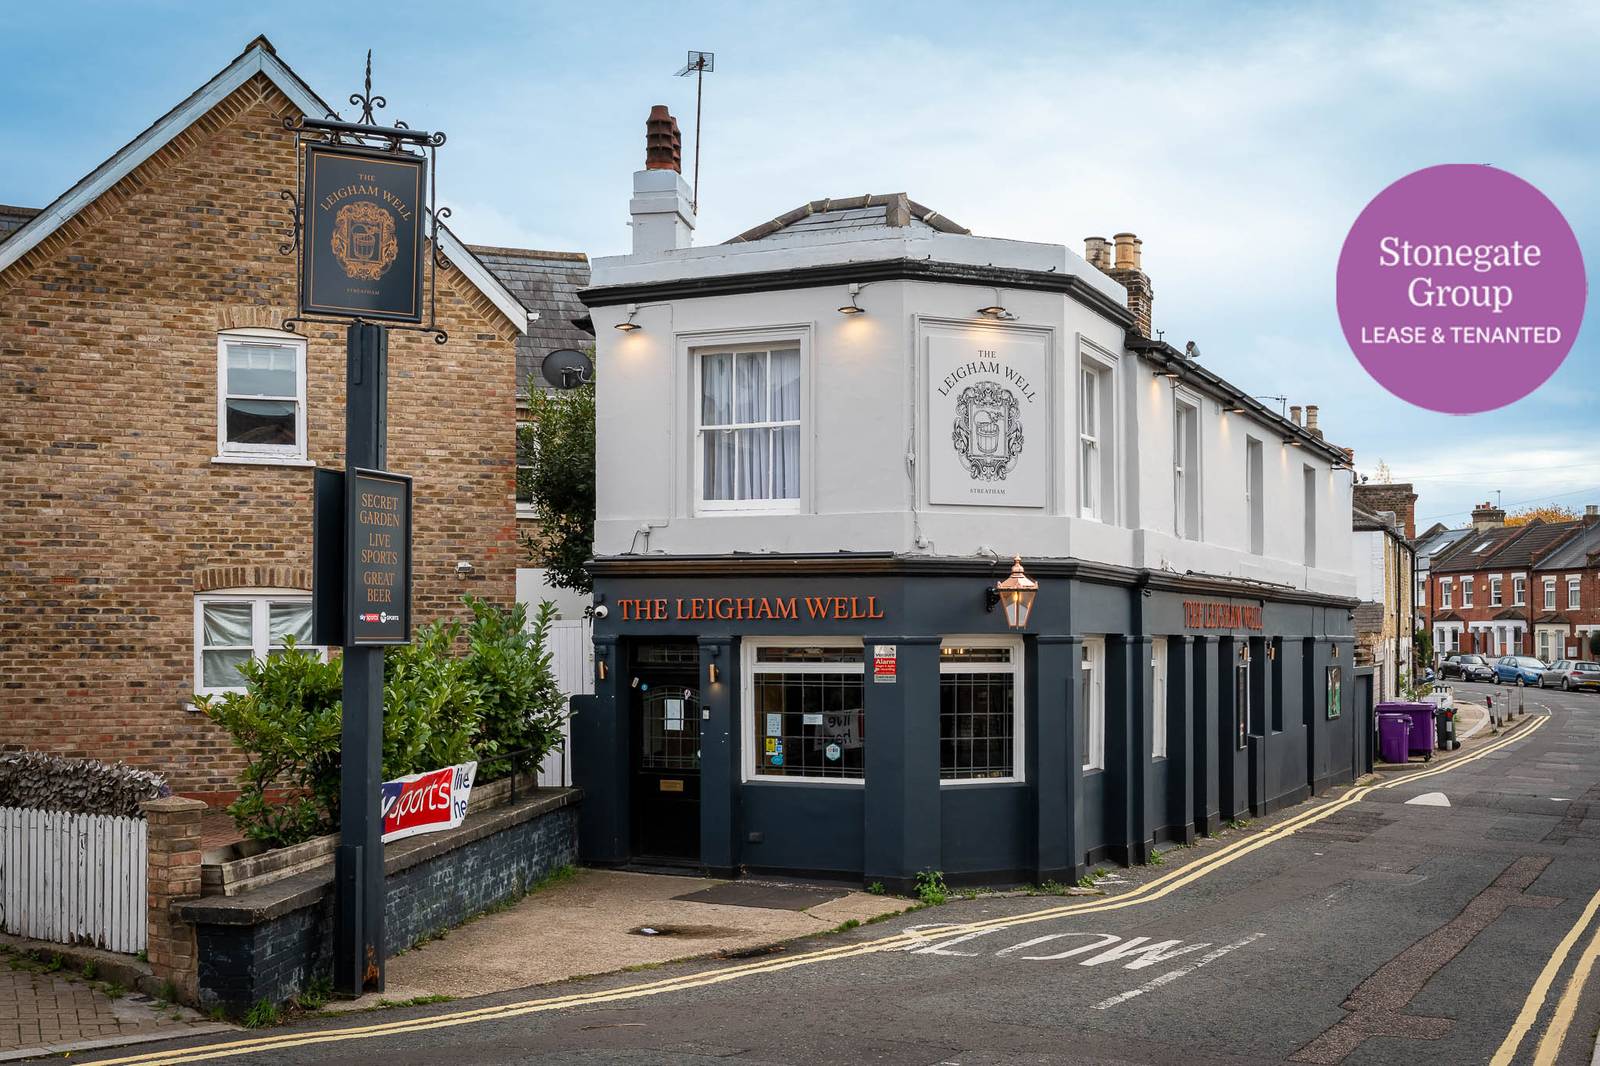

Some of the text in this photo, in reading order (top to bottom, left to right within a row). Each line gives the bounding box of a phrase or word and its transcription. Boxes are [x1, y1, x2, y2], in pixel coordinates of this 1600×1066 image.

[358, 174, 376, 182] THE
[320, 185, 413, 222] LEIGHAM WELL
[977, 350, 997, 359] THE
[937, 361, 1038, 403] LEIGHAM WELL
[361, 493, 399, 509] SECRET
[359, 511, 400, 527] GARDEN
[369, 533, 391, 548] LIVE
[361, 549, 398, 565] SPORTS
[363, 571, 395, 586] GREAT
[367, 589, 392, 603] BEER
[618, 596, 884, 621] THE LEIGHAM WELL
